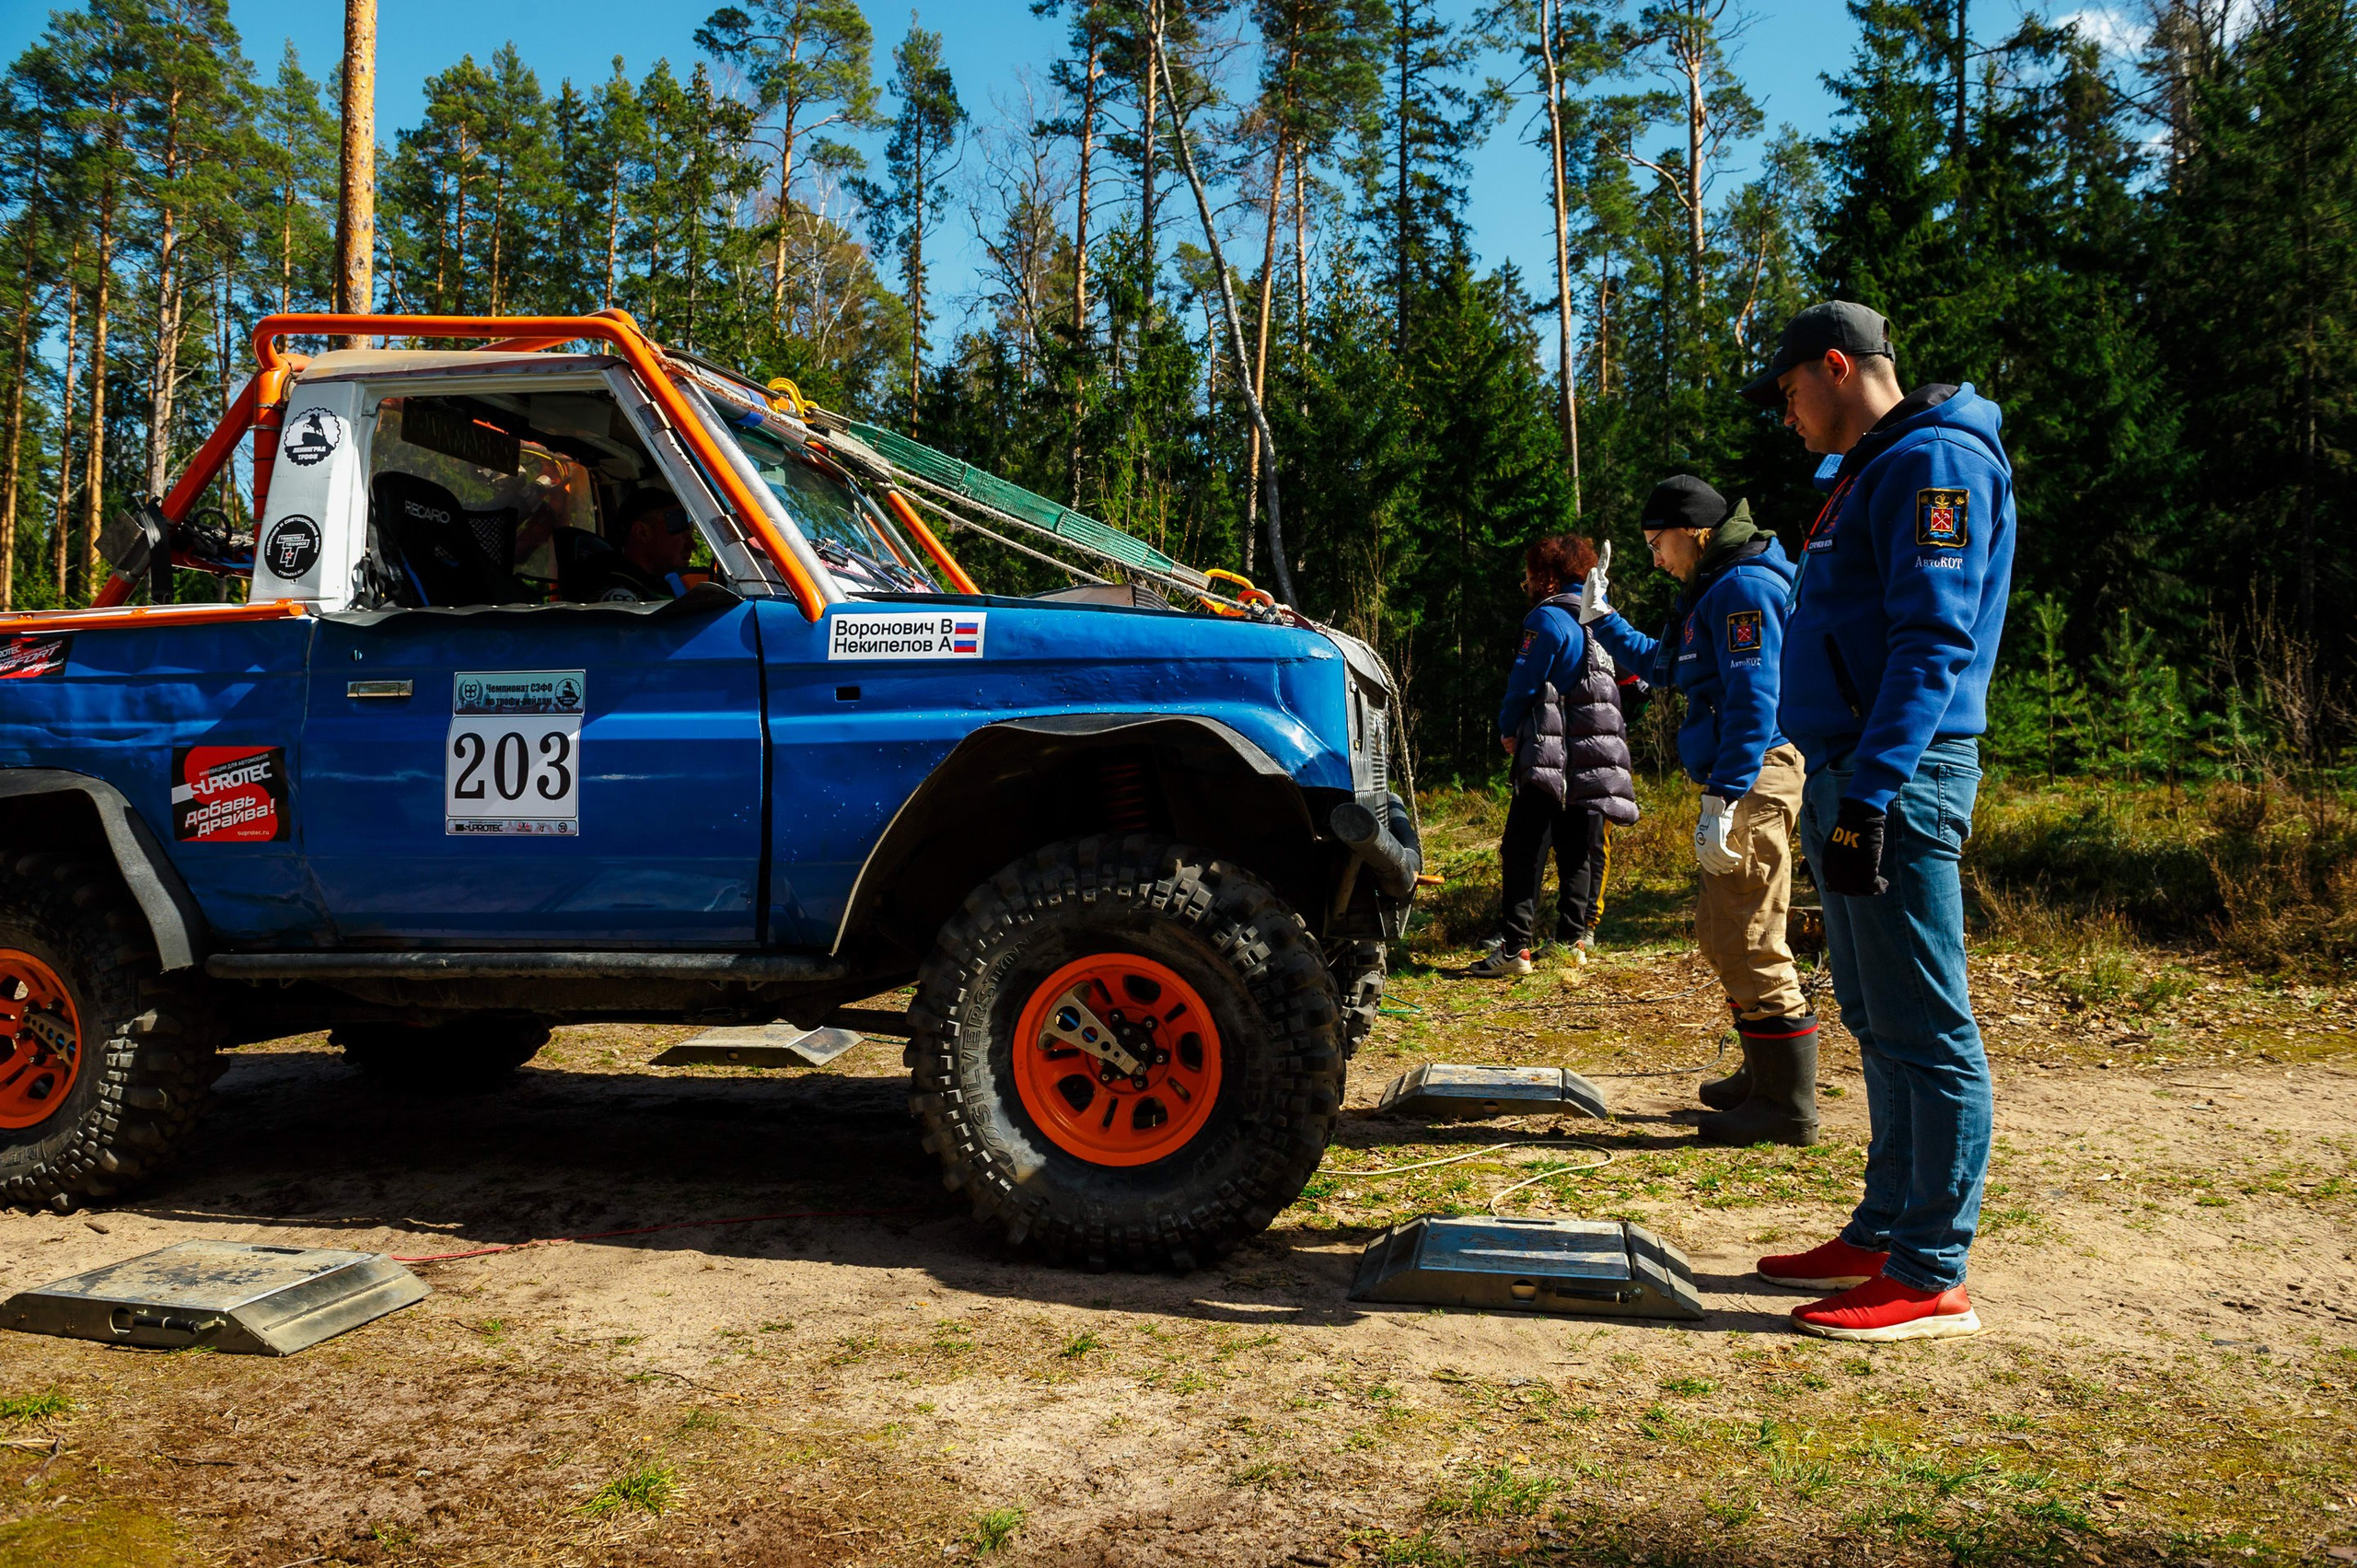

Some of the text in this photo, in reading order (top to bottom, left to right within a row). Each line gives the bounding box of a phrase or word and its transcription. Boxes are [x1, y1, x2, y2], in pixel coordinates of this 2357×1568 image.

[405, 500, 450, 524] RECARO
[835, 618, 953, 640] Воронович В
[833, 636, 953, 654] Некипелов А
[485, 682, 552, 692] Чемпионат СЗФО
[454, 731, 571, 800] 203
[188, 761, 273, 795] SUPROTEC
[185, 796, 257, 828] добавь
[198, 797, 275, 838] драйва!
[237, 830, 270, 840] suprotec.ru
[1831, 826, 1861, 849] DK
